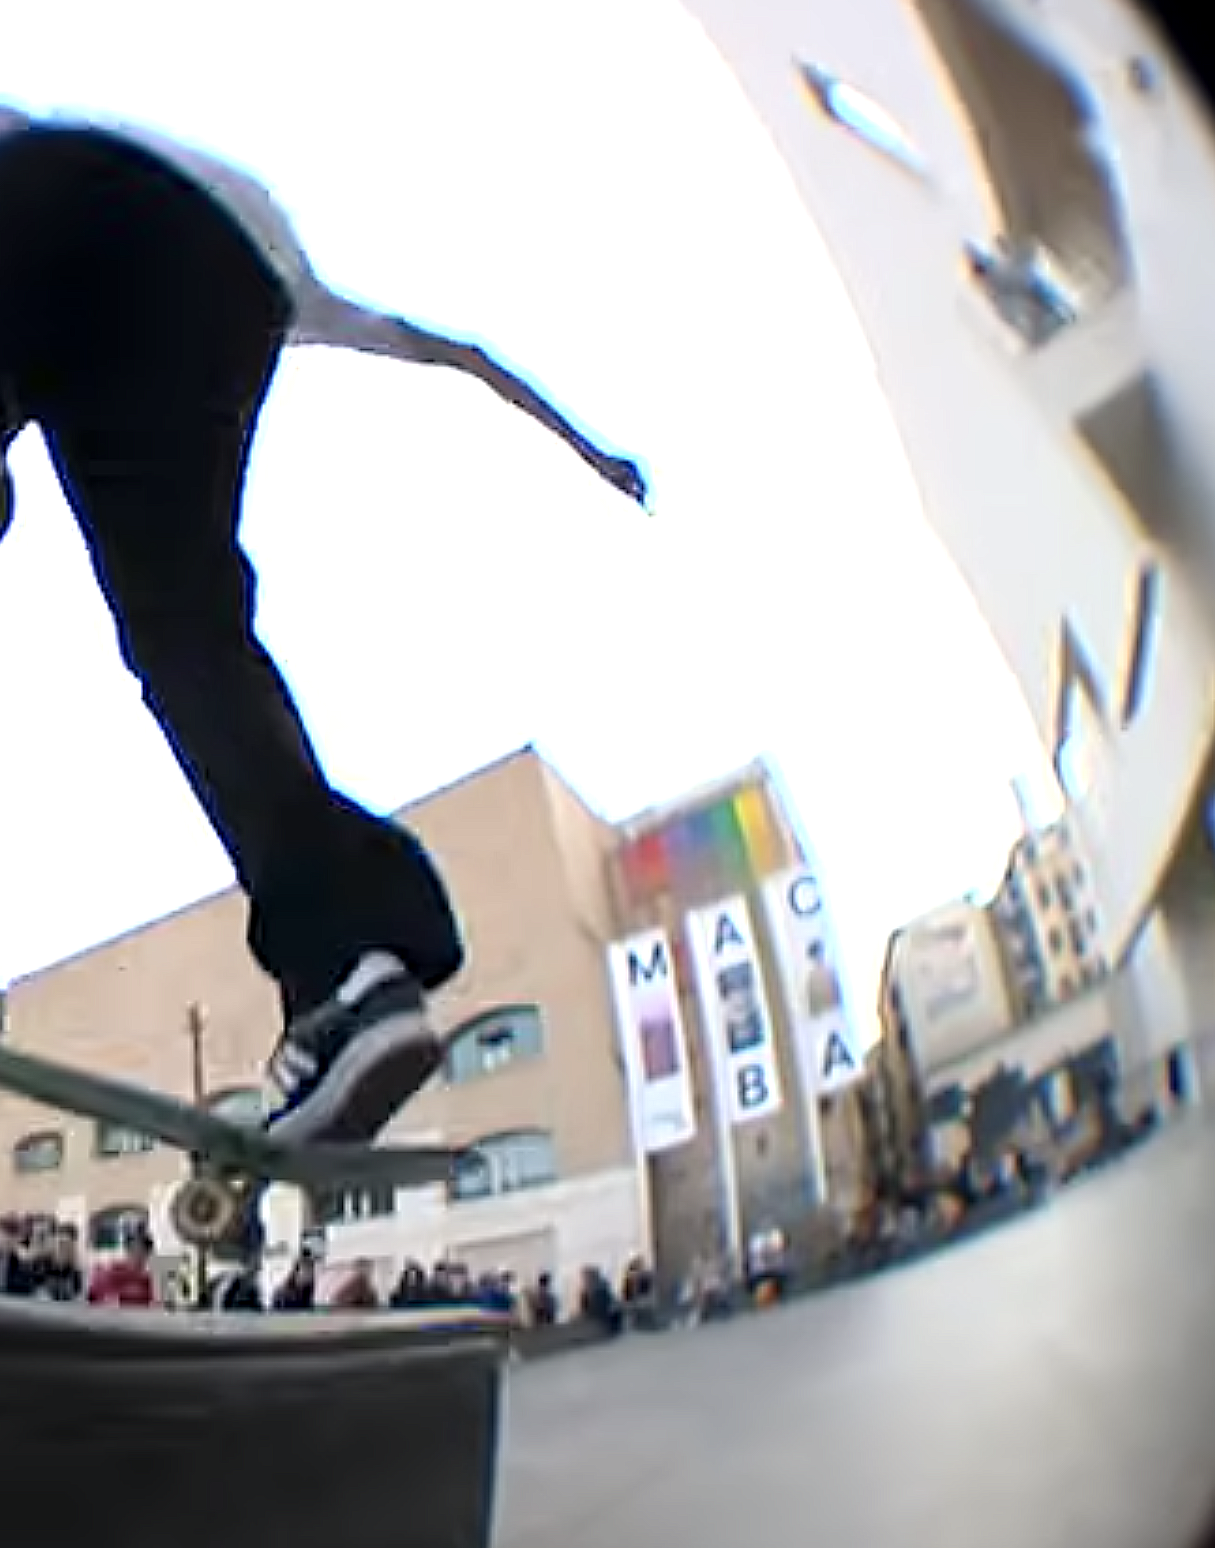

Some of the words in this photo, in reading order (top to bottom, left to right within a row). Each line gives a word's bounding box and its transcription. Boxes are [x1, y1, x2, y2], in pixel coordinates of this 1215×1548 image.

[789, 877, 822, 915] C
[714, 913, 744, 955] A
[628, 942, 668, 985] M
[822, 1031, 854, 1077] A
[738, 1065, 769, 1107] B
